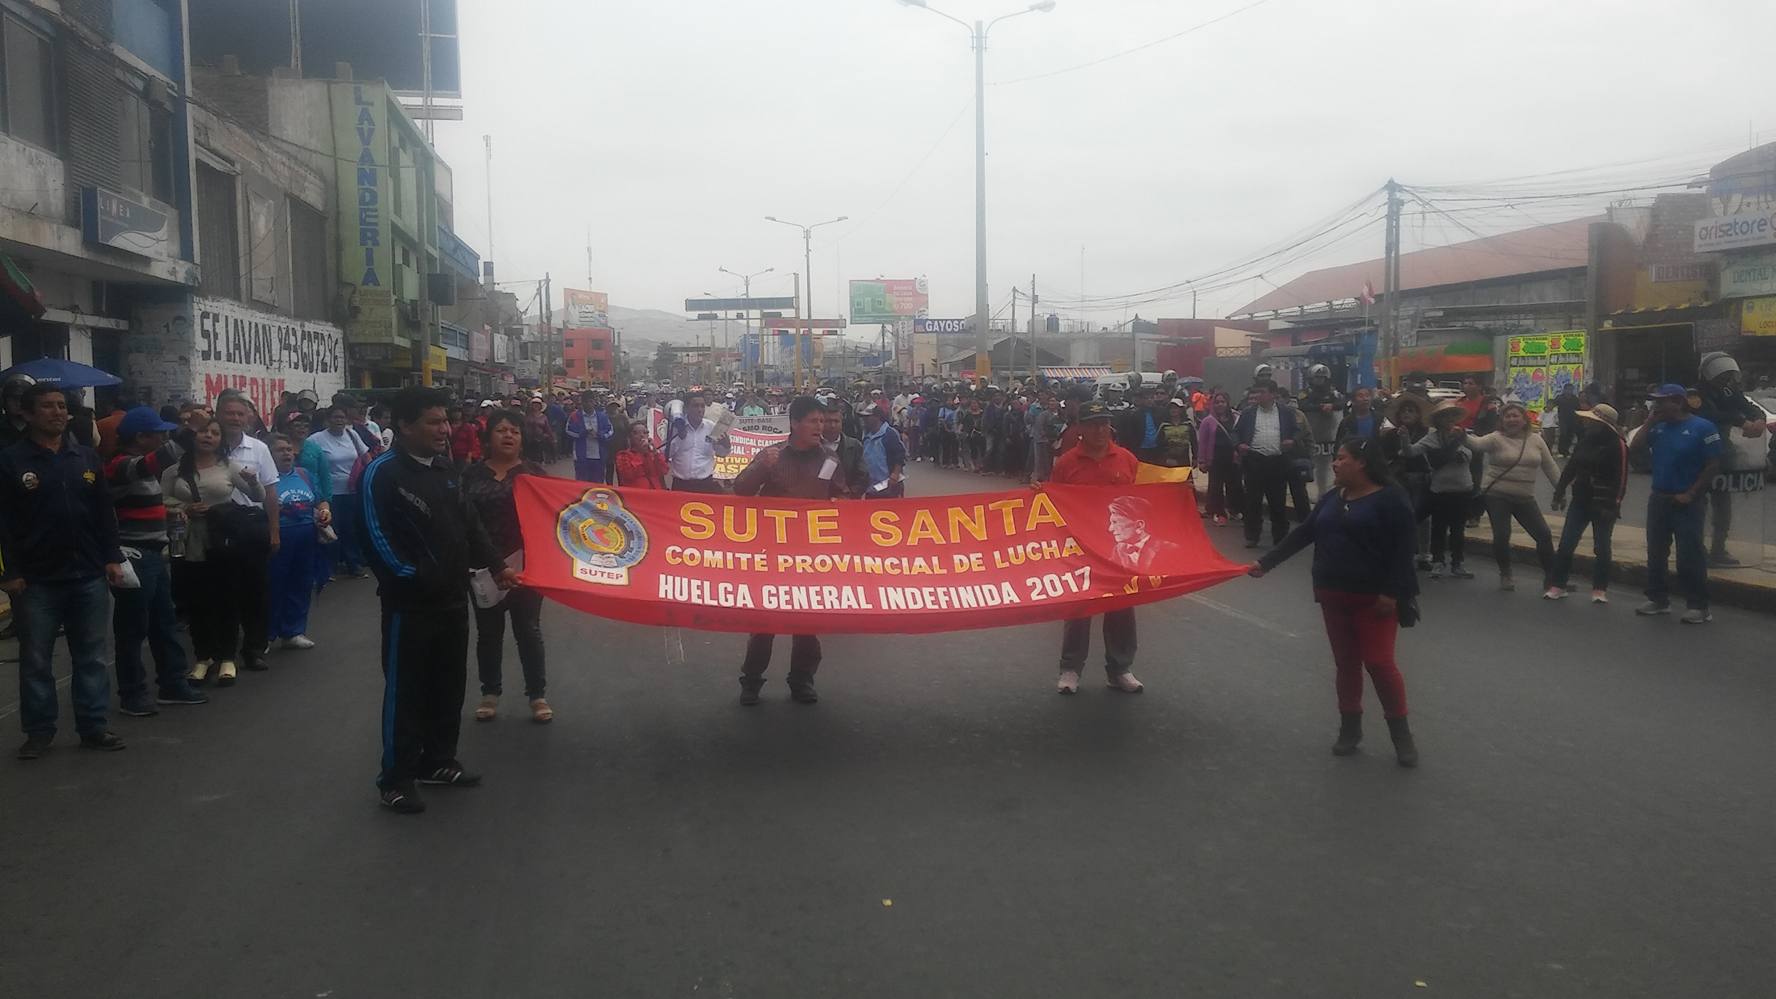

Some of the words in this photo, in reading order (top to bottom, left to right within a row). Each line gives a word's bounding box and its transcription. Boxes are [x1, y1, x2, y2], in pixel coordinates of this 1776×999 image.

[353, 85, 381, 287] LAVANDERIA
[201, 311, 221, 361] SE
[225, 314, 273, 367] LAVAN
[680, 501, 842, 544] SUTE
[870, 492, 1067, 547] SANTA
[579, 567, 624, 581] SUTEP
[665, 545, 768, 572] COMITÉ
[778, 554, 947, 575] PROVINCIAL
[954, 552, 986, 574] DE
[993, 536, 1085, 568] LUCHA
[659, 574, 755, 608] HUELGA
[762, 584, 873, 610] GENERAL
[878, 582, 1021, 610] INDEFINIDA
[1026, 566, 1092, 600] 2017
